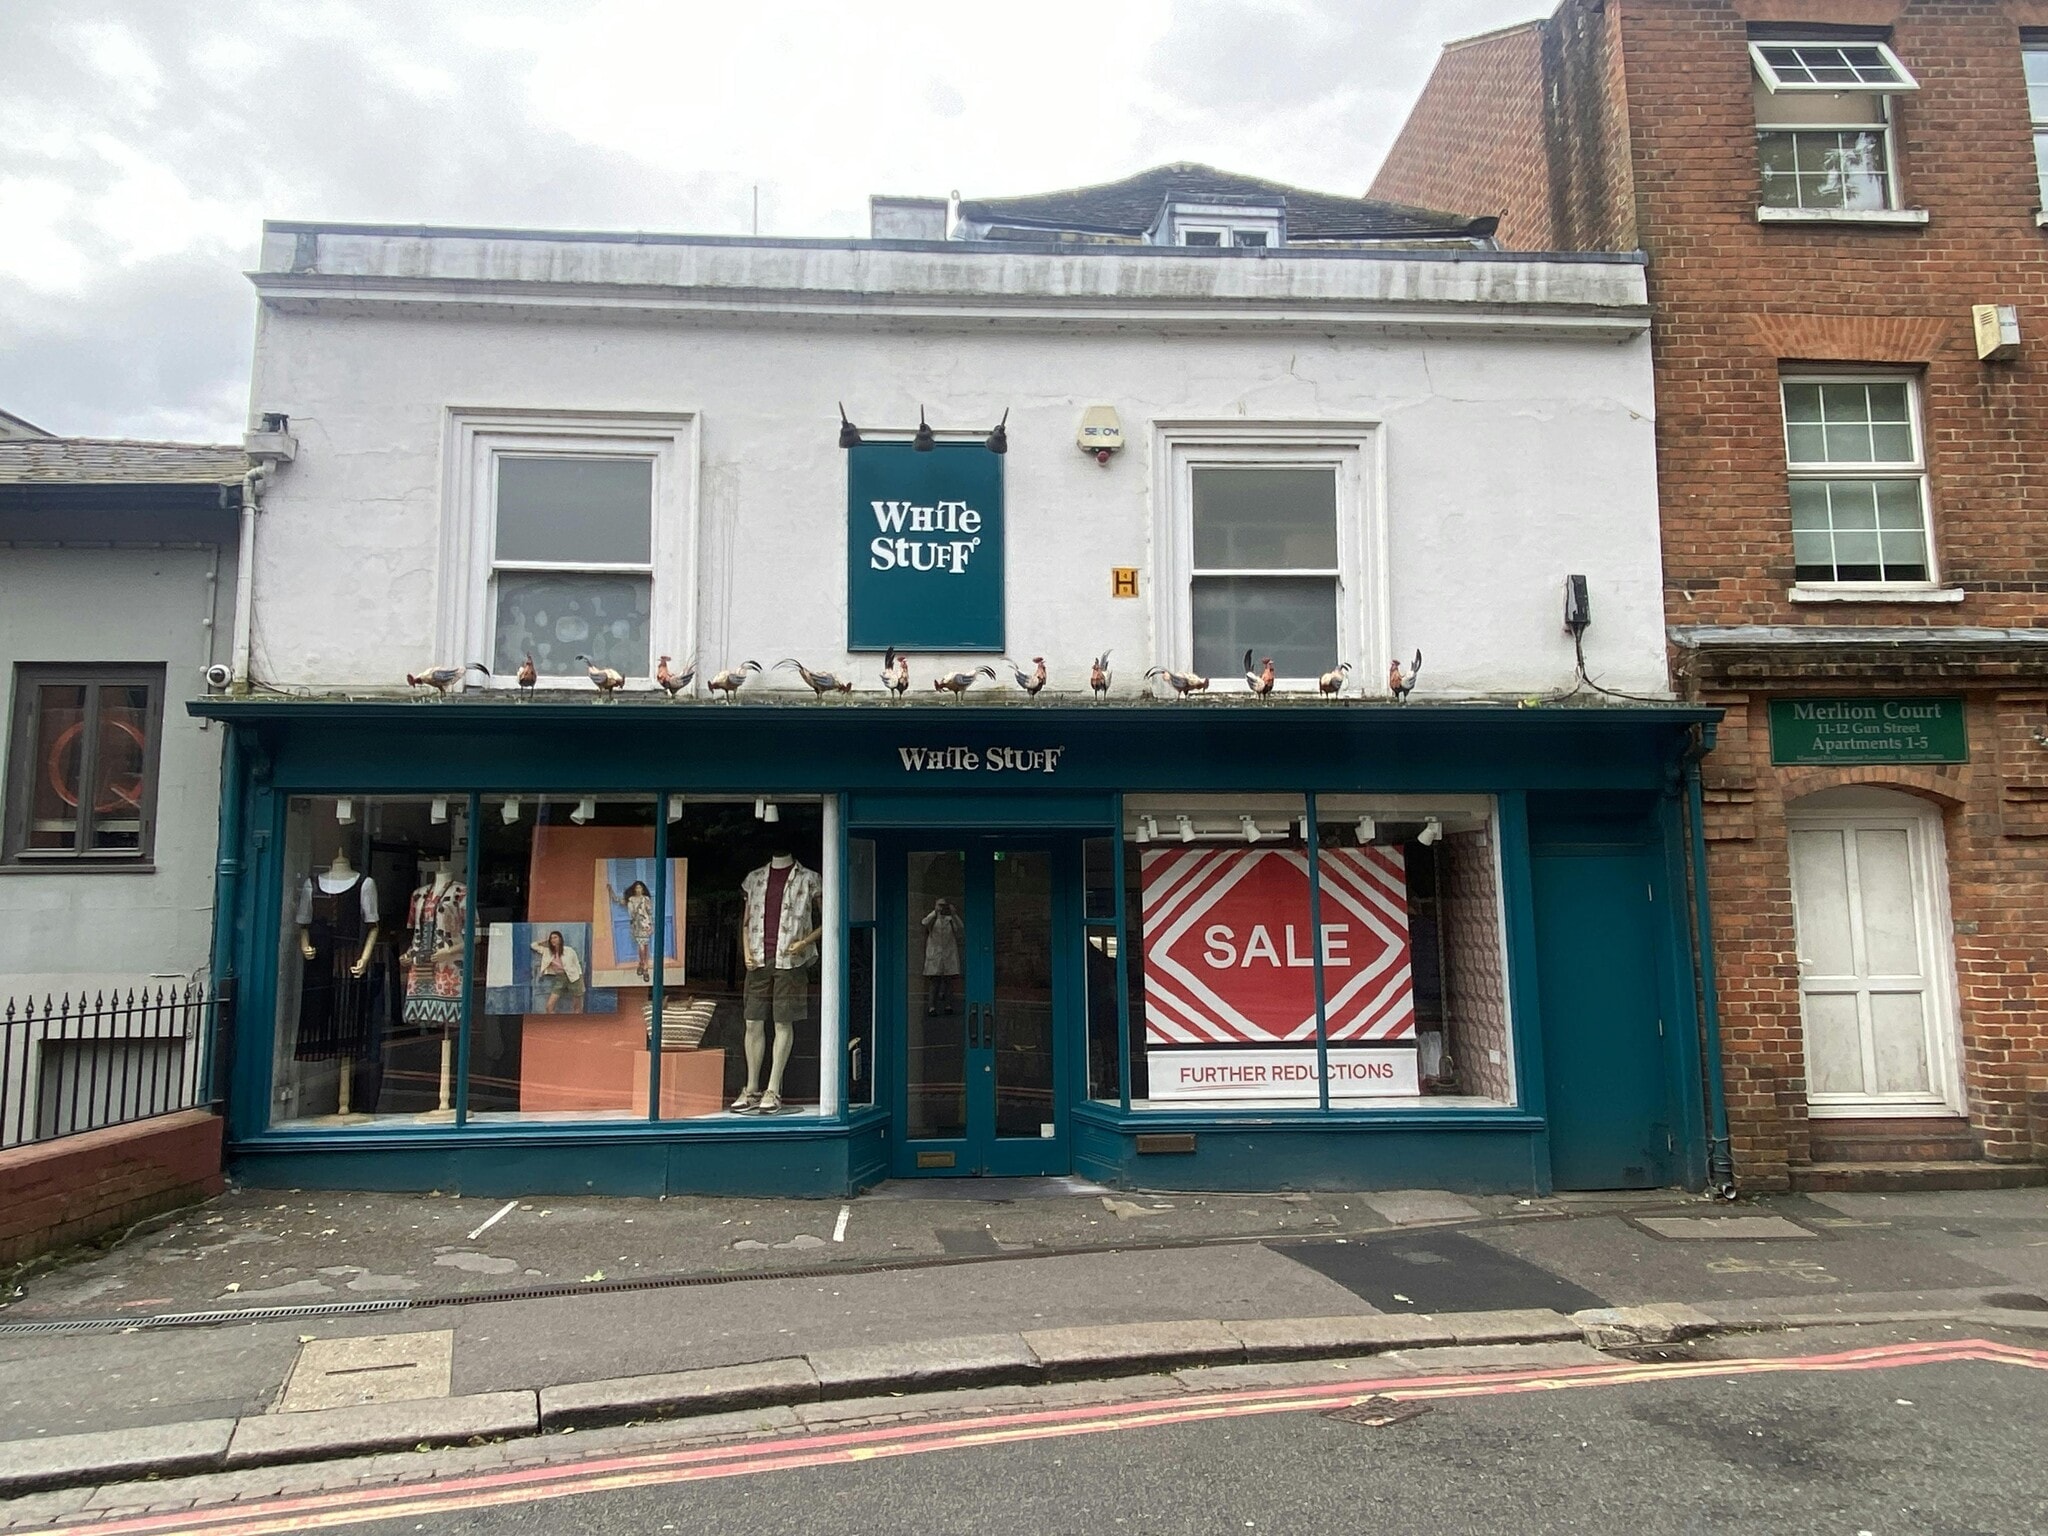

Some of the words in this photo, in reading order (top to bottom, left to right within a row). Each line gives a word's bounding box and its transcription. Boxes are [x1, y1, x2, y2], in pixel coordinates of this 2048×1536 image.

[1793, 702, 1877, 720] Merlion
[1883, 701, 1942, 719] Court
[1816, 723, 1850, 734] 11-12
[1852, 722, 1880, 734] Gun
[1883, 722, 1921, 734] Street
[1812, 737, 1903, 754] Apartments
[1905, 736, 1929, 750] 1-5
[1202, 923, 1351, 970] SALE
[1179, 1065, 1267, 1084] FURTHER
[1271, 1063, 1395, 1082] REDUCTIONS
